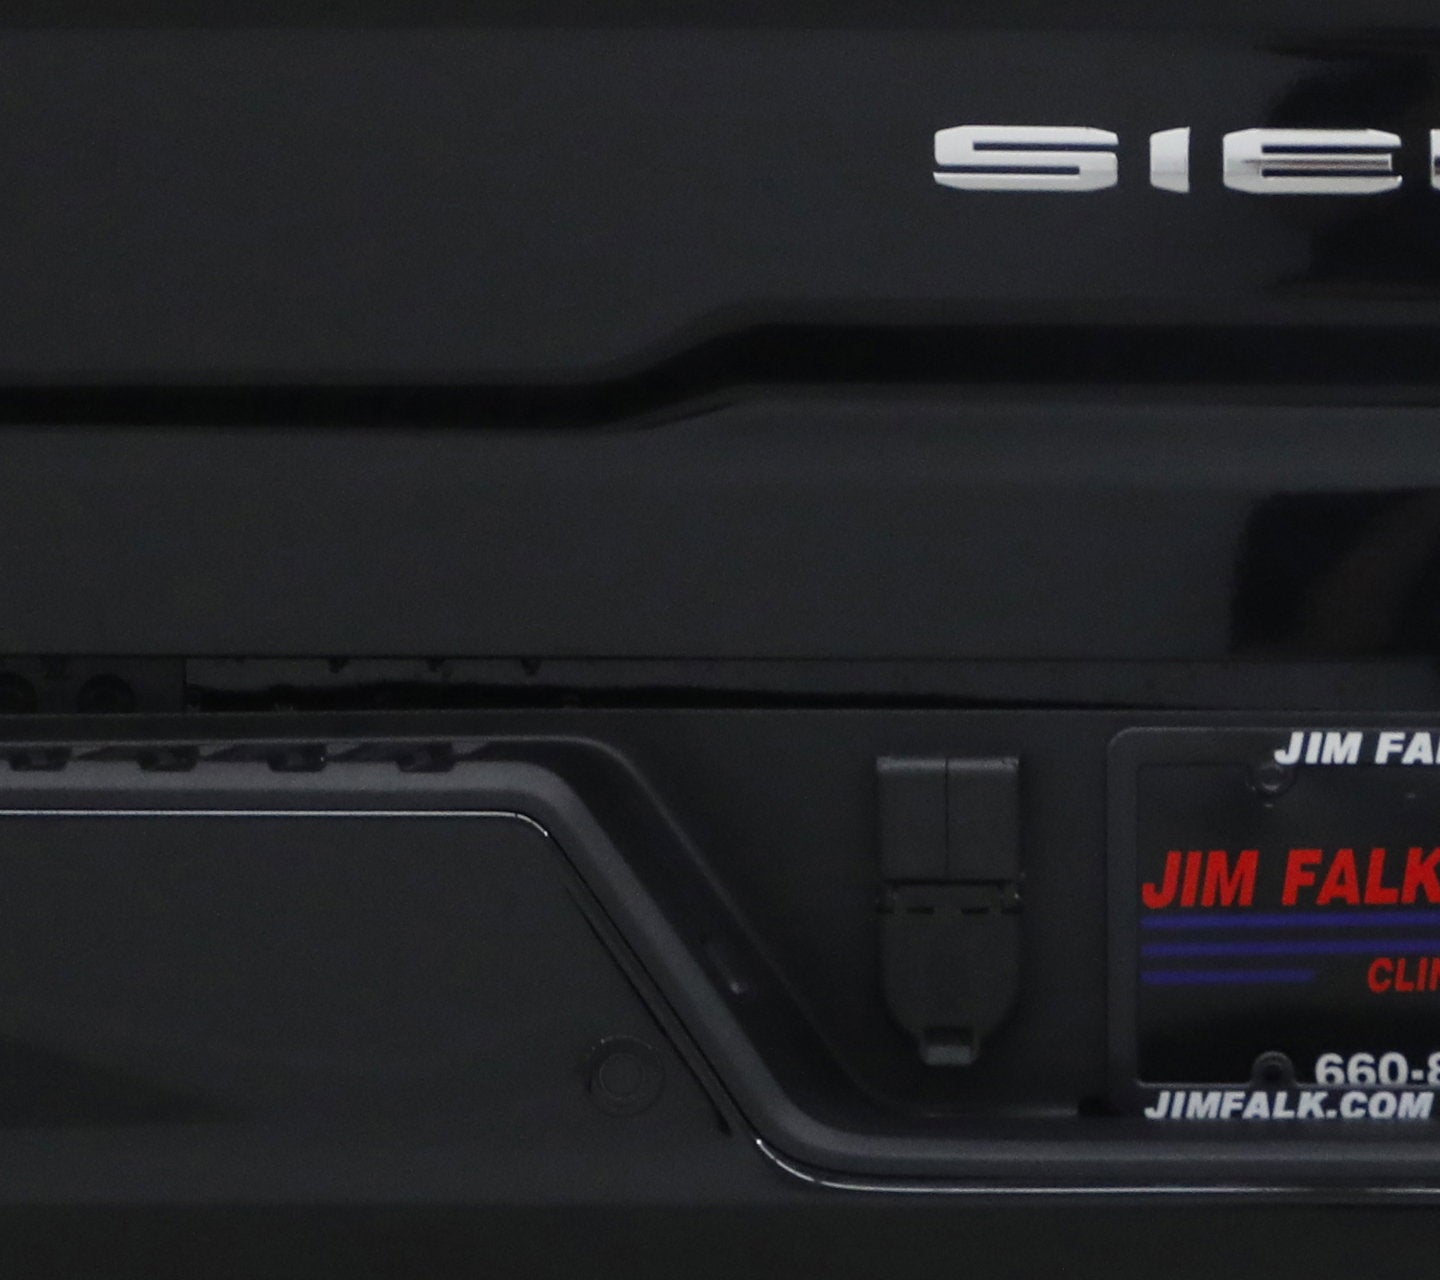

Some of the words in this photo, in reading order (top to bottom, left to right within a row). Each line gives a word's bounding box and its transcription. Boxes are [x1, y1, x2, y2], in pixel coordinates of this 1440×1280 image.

[1273, 731, 1362, 765] JIM
[1141, 848, 1259, 910] JIM
[1143, 1091, 1435, 1120] JIMFALK.COM
